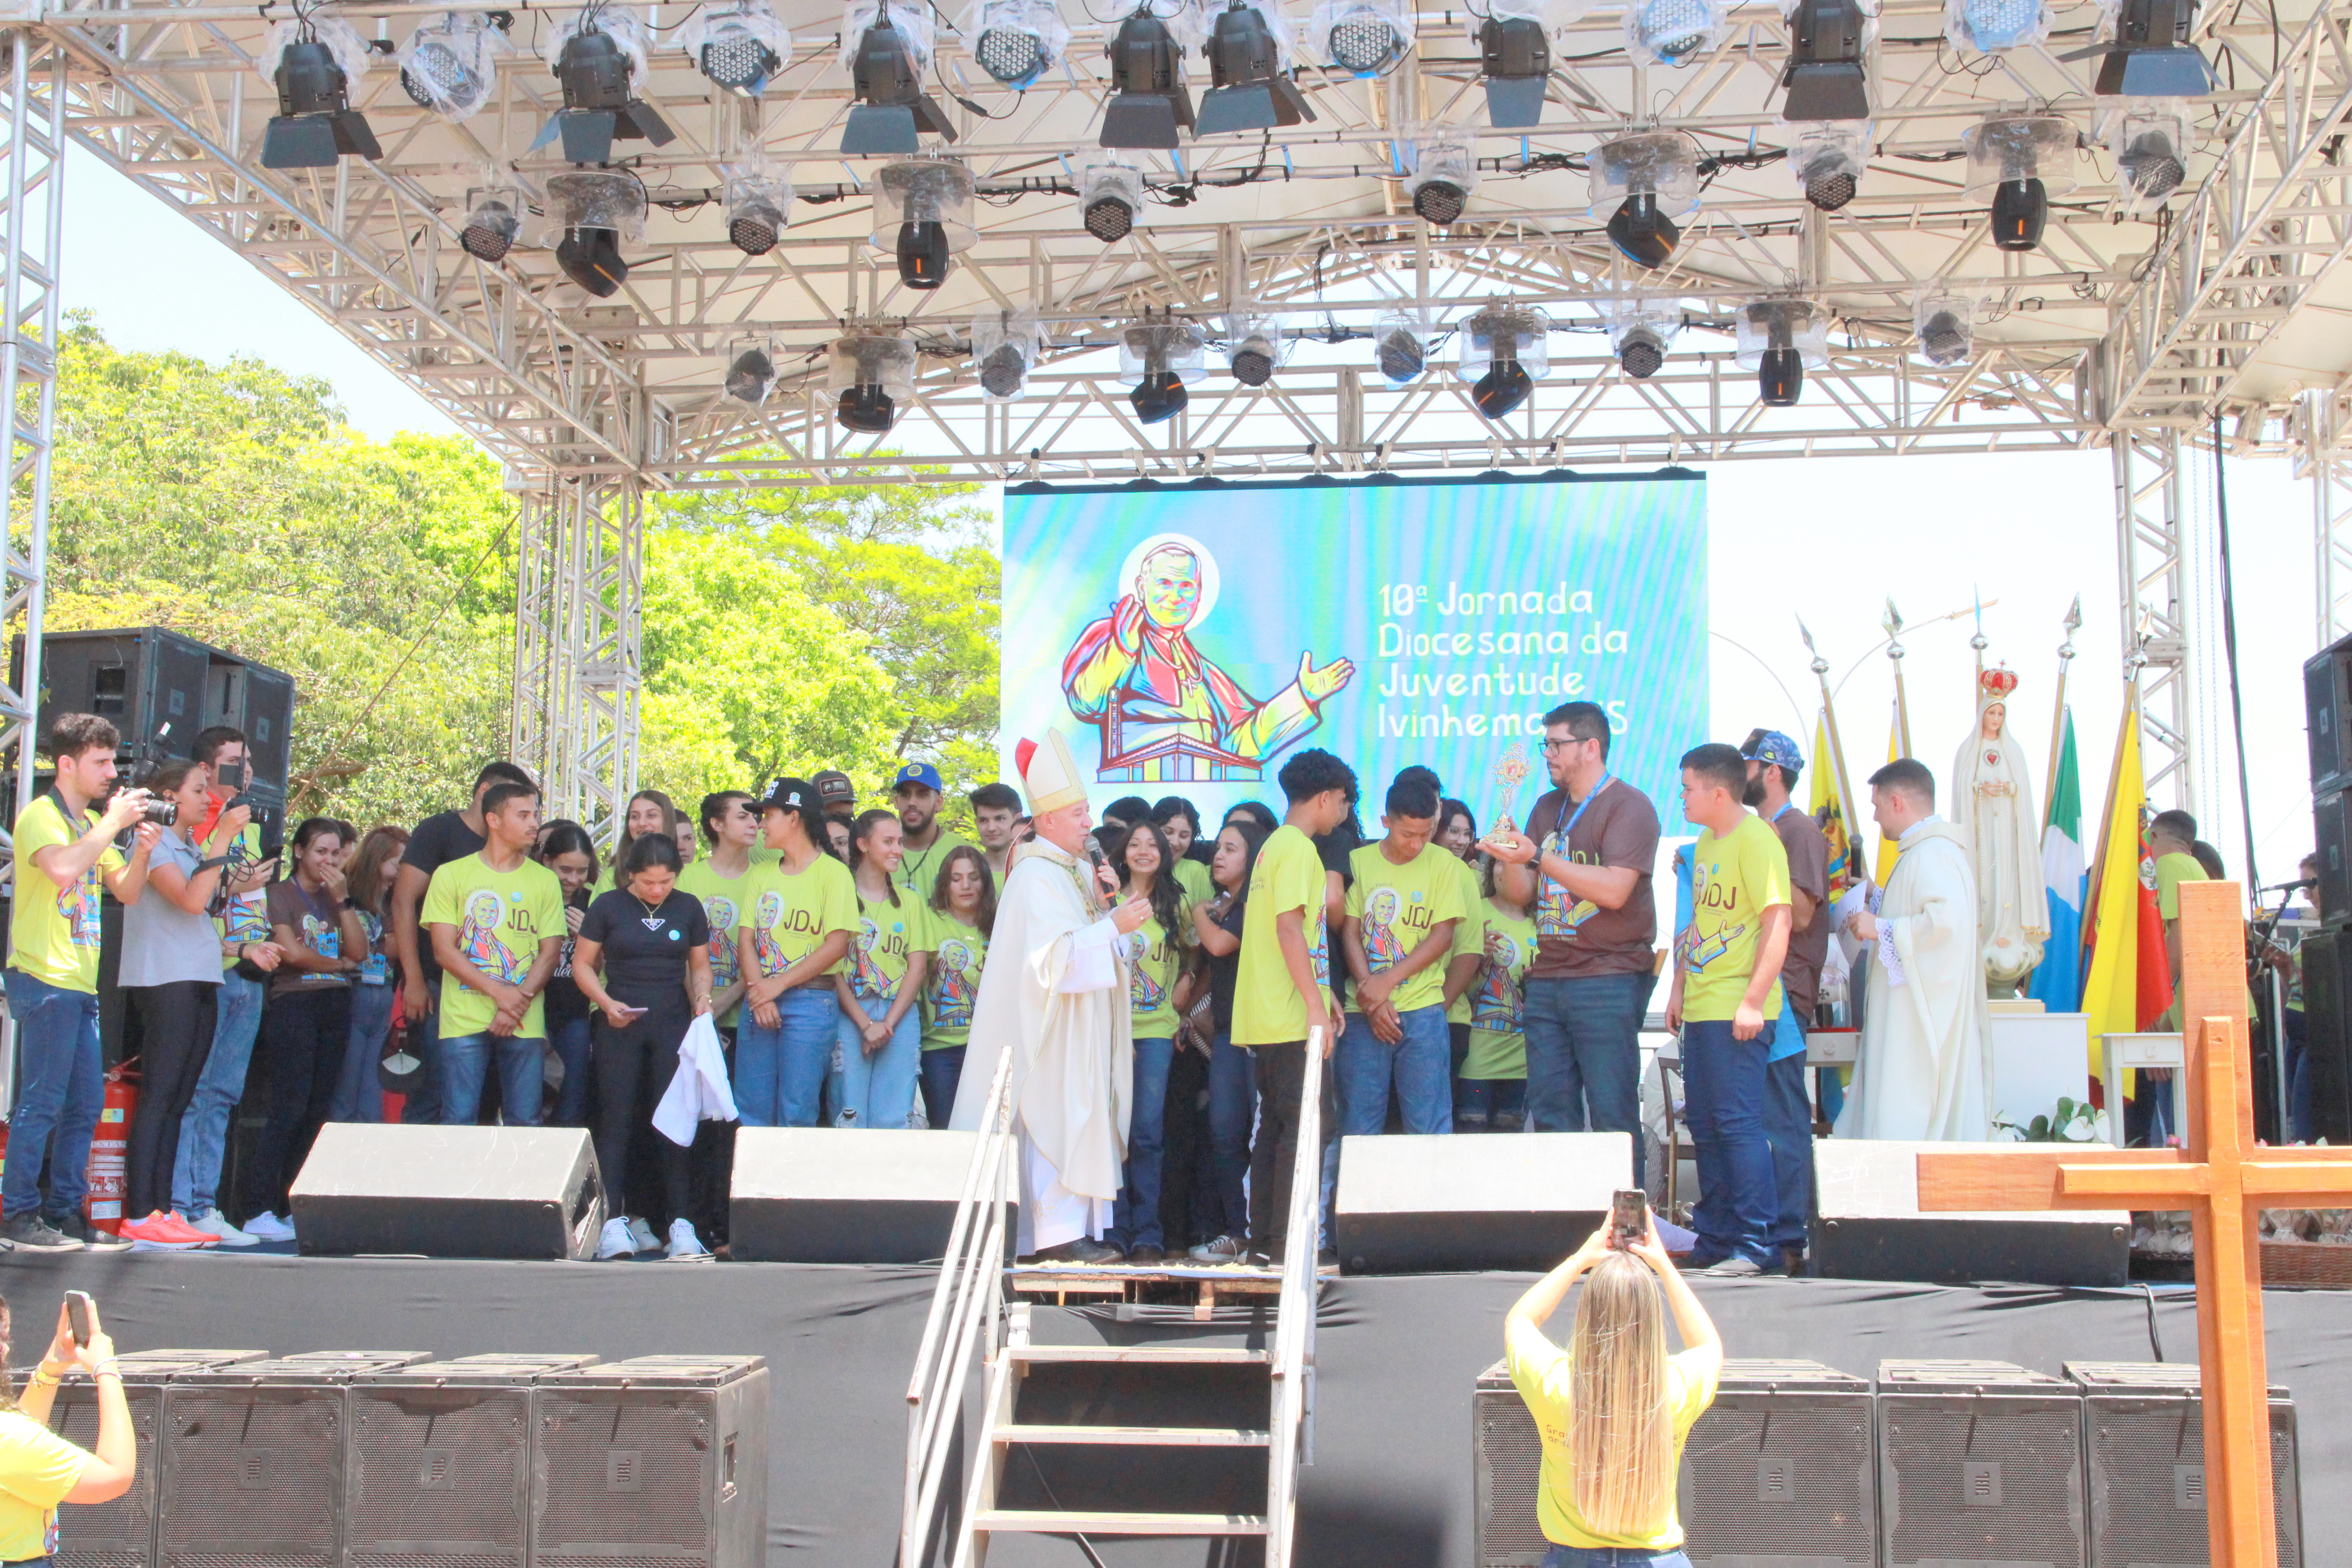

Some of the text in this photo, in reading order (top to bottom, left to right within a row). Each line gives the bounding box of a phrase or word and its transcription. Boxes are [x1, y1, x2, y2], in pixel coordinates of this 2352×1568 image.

[1436, 581, 1593, 616] Jornada
[1378, 621, 1628, 657] Diocesana da
[1379, 662, 1586, 697] Juventude
[1701, 883, 1736, 910] JDJ
[507, 908, 538, 935] JDJ
[784, 908, 823, 936] JDJ
[1401, 905, 1434, 929] JDJ
[247, 1456, 261, 1481] JBL
[431, 1457, 445, 1481] JBL
[617, 1459, 631, 1483] JBL
[1768, 1467, 1783, 1493] JBL
[1975, 1471, 1990, 1496] JBL
[2186, 1475, 2201, 1501] JBL
